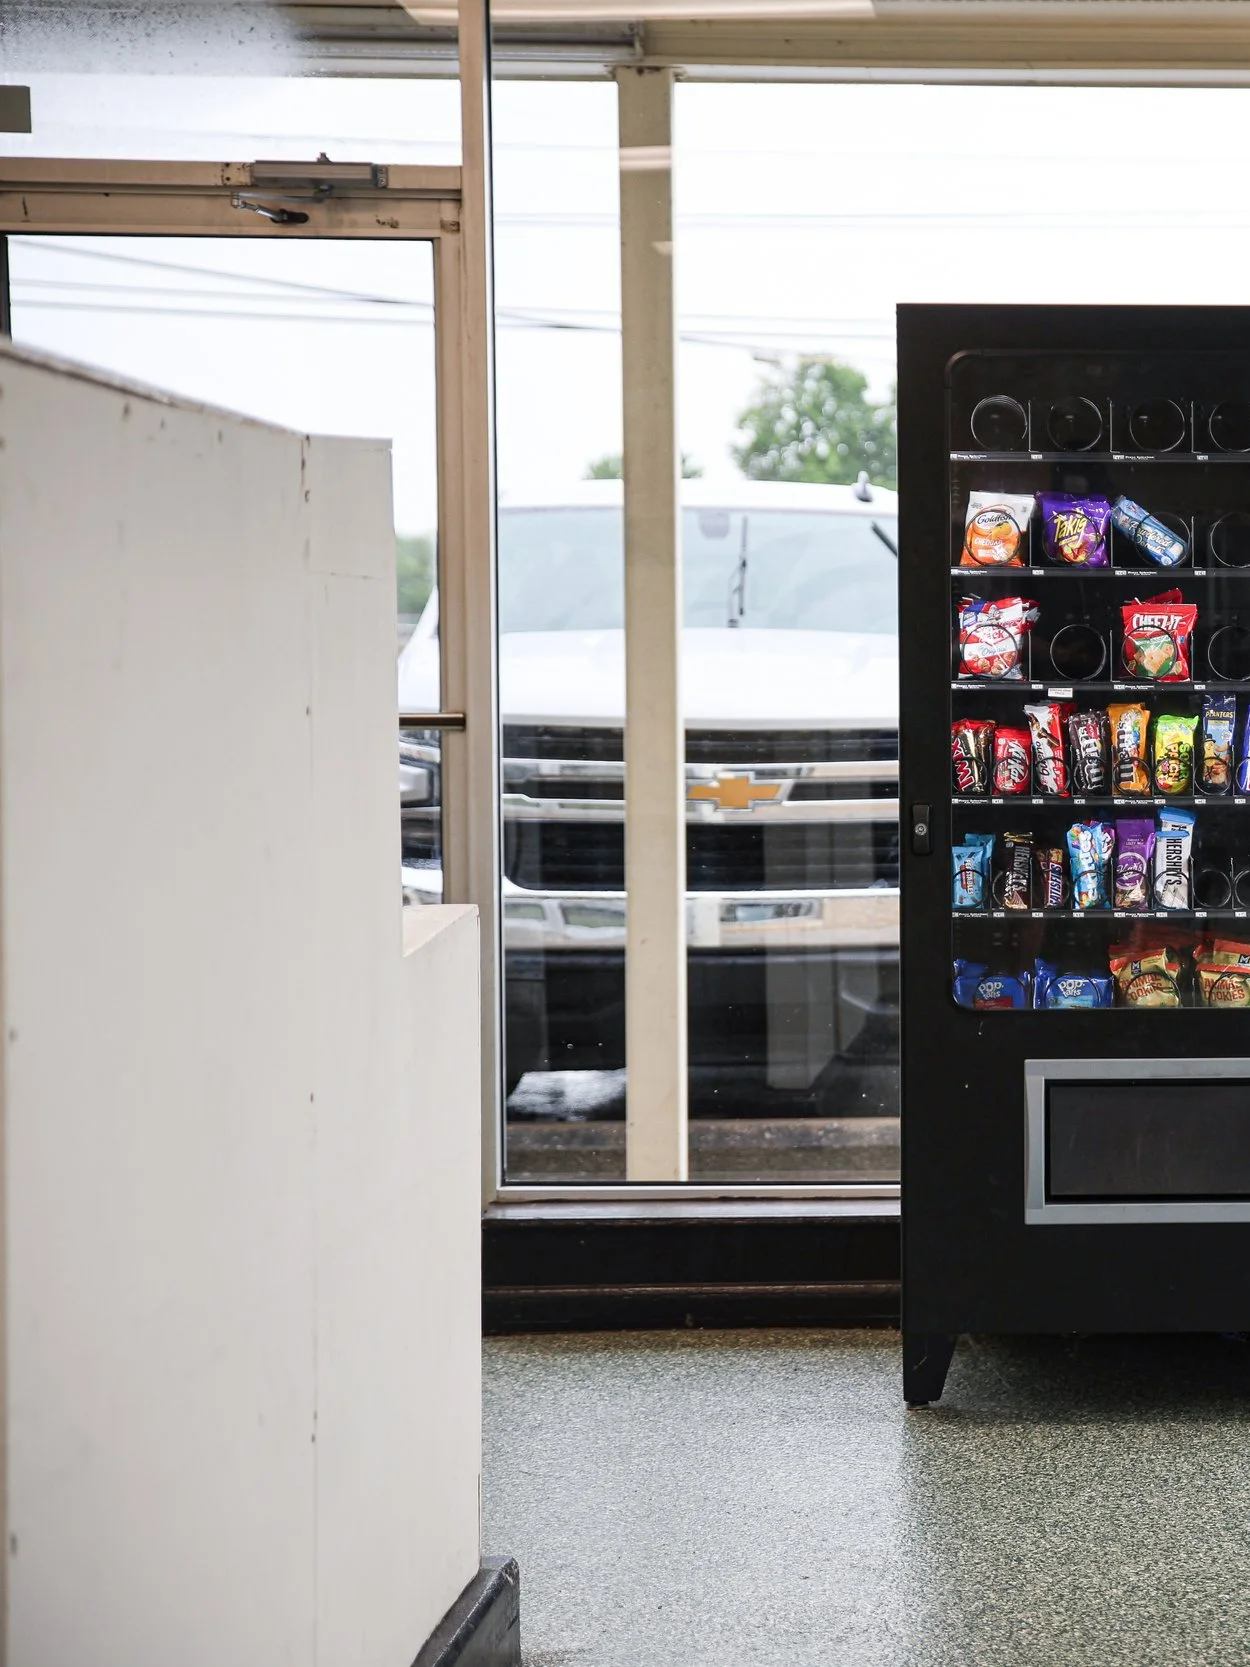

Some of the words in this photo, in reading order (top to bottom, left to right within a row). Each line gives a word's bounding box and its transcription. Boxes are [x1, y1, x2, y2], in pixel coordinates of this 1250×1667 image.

[977, 512, 1013, 524] Goldfish
[1054, 514, 1088, 541] Takis
[1130, 519, 1172, 547] Pwdered
[1132, 613, 1183, 632] CHEEZ-IT
[951, 738, 974, 792] TWIX
[1035, 741, 1050, 776] bueno
[1179, 742, 1190, 779] SOUR
[1012, 845, 1031, 892] HERSHEY'S
[1165, 838, 1182, 885] HERSHEY'S
[1129, 982, 1163, 1001] OOKIES
